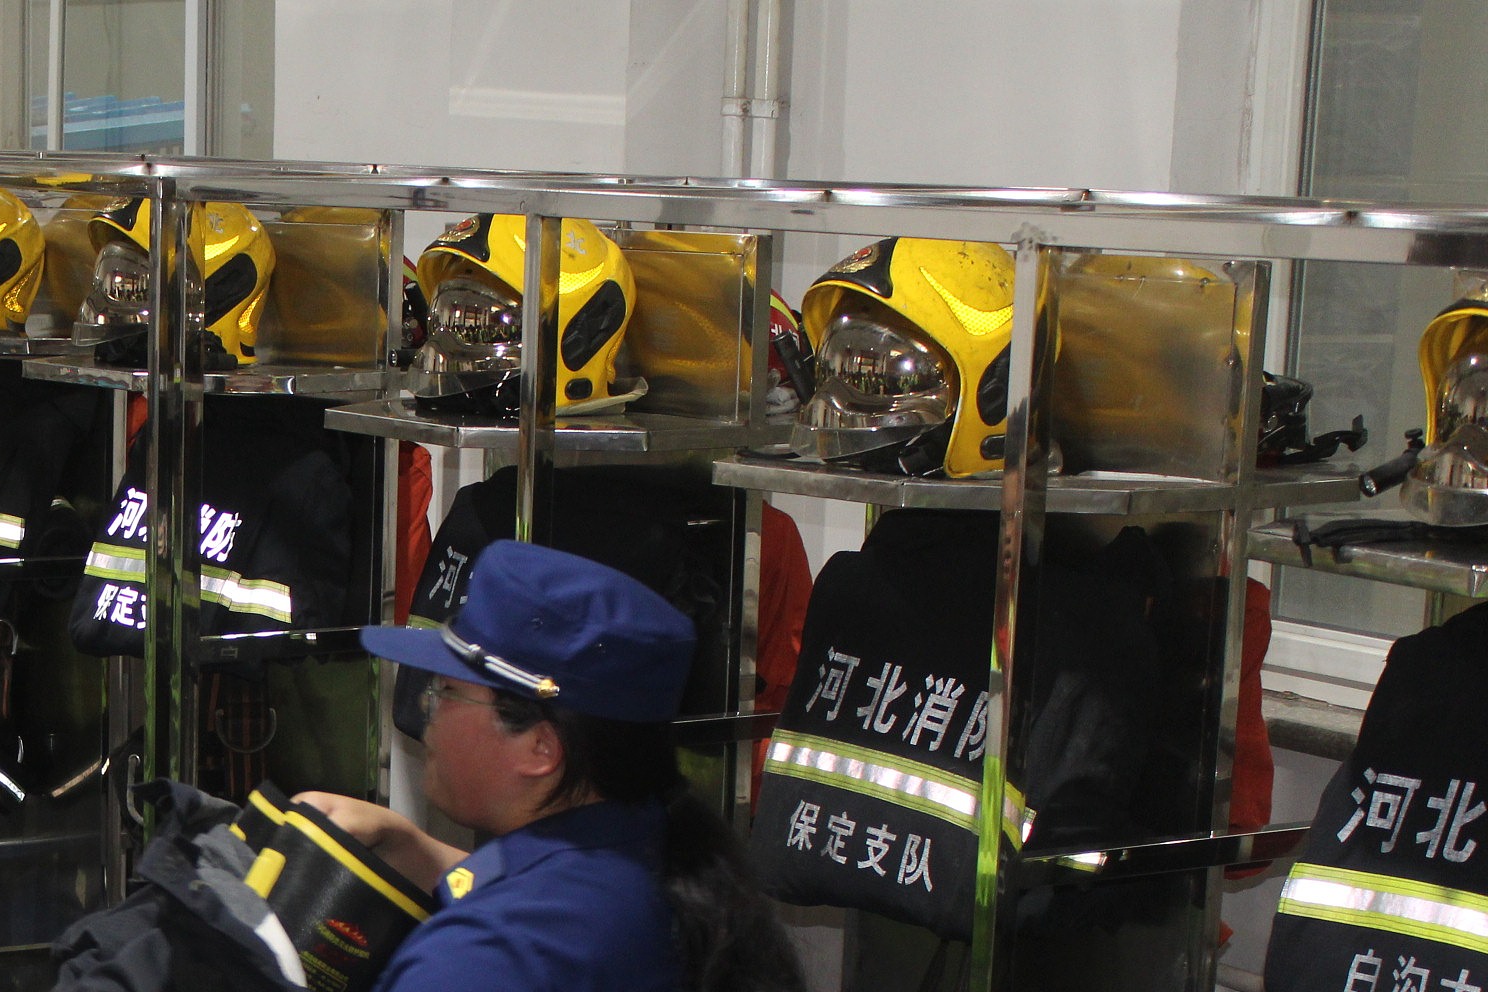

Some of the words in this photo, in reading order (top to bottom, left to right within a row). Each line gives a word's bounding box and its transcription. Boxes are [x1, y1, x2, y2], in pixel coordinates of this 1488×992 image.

[429, 546, 474, 609] 河
[786, 799, 934, 893] 保定支队
[1336, 767, 1488, 863] 河北
